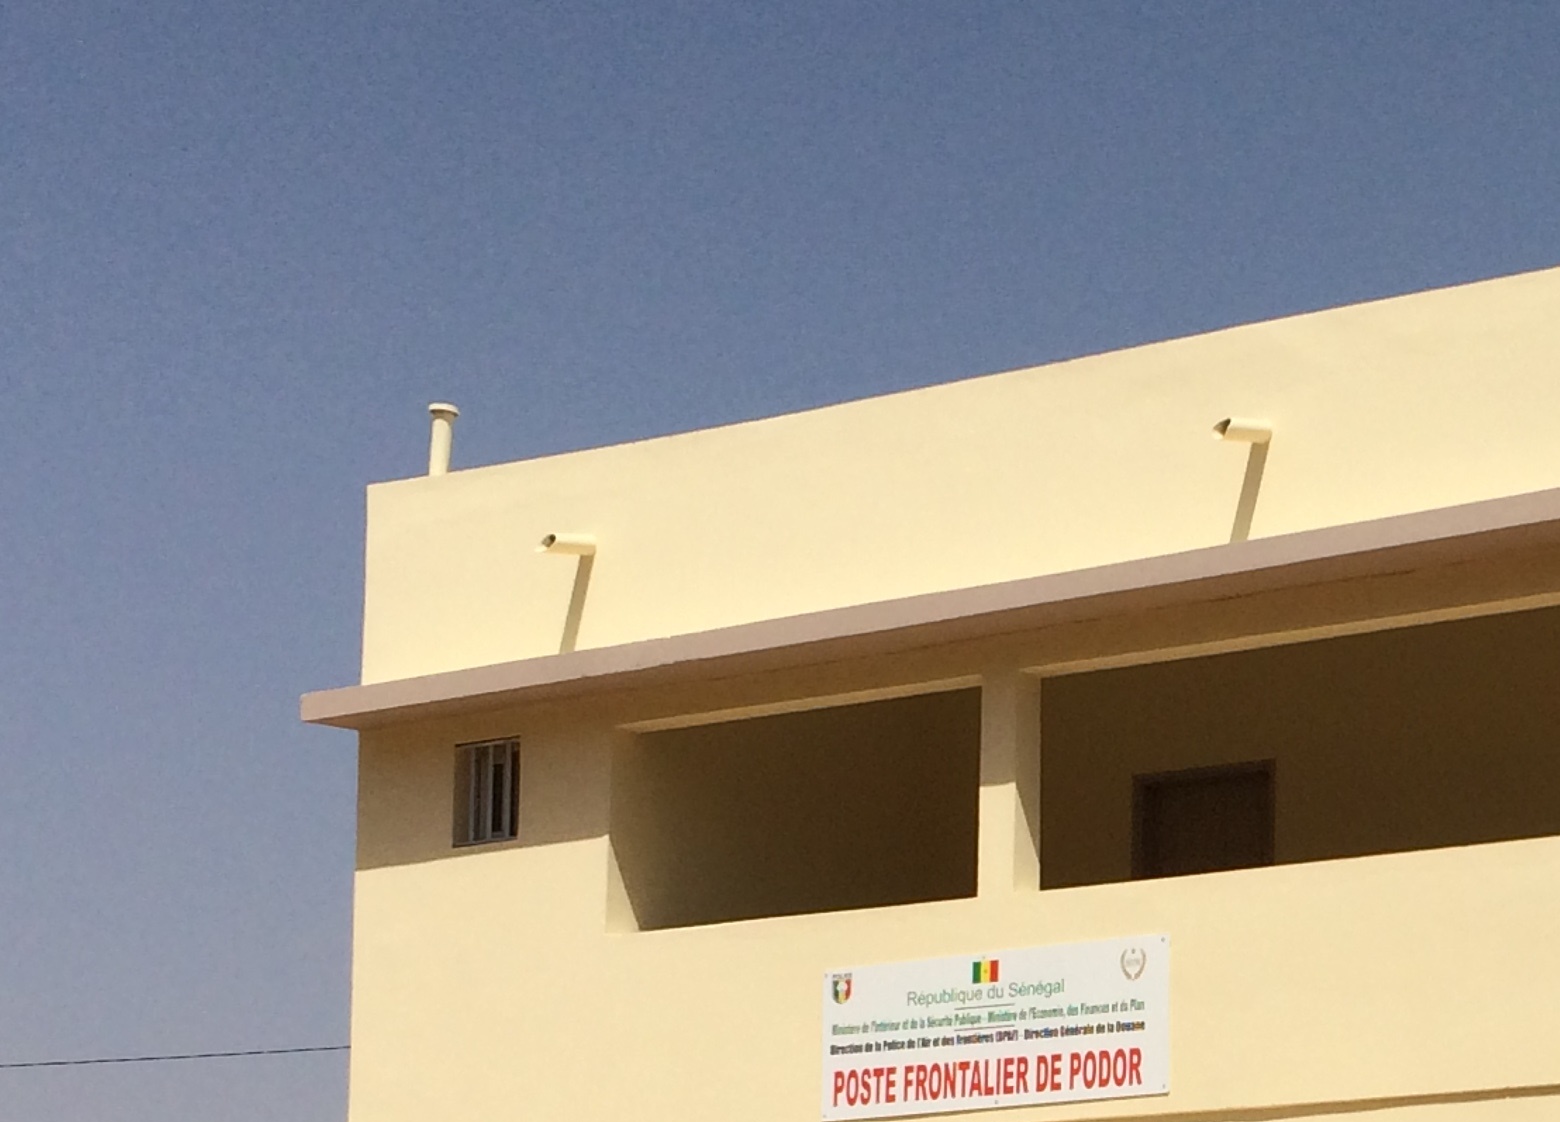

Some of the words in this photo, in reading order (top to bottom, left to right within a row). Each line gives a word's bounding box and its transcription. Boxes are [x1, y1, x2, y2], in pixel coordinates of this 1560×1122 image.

[906, 986, 983, 1007] République
[987, 984, 1004, 999] du
[1008, 979, 1065, 999] Sénégal
[862, 1021, 869, 1033] de
[902, 1019, 908, 1030] et
[910, 1018, 917, 1029] de
[920, 1017, 925, 1028] la
[954, 1012, 981, 1027] Publique
[1019, 1008, 1027, 1020] de
[1067, 1004, 1078, 1016] des
[1081, 1002, 1109, 1015] Finances
[1112, 1001, 1118, 1012] et
[1120, 1000, 1128, 1012] du
[1130, 998, 1145, 1011] Plan
[830, 1043, 863, 1055] Direction
[865, 1042, 873, 1052] de
[875, 1040, 881, 1051] la
[883, 1039, 905, 1051] Police
[907, 1038, 915, 1049] de
[933, 1036, 940, 1047] et
[941, 1035, 954, 1046] des
[1024, 1027, 1058, 1040] Direction
[1096, 1022, 1105, 1034] de
[1107, 1021, 1114, 1033] la
[833, 1067, 897, 1107] POSTE
[903, 1056, 1029, 1102] FRONTALIER
[1035, 1053, 1062, 1092] DE
[1069, 1047, 1142, 1090] PODOR
